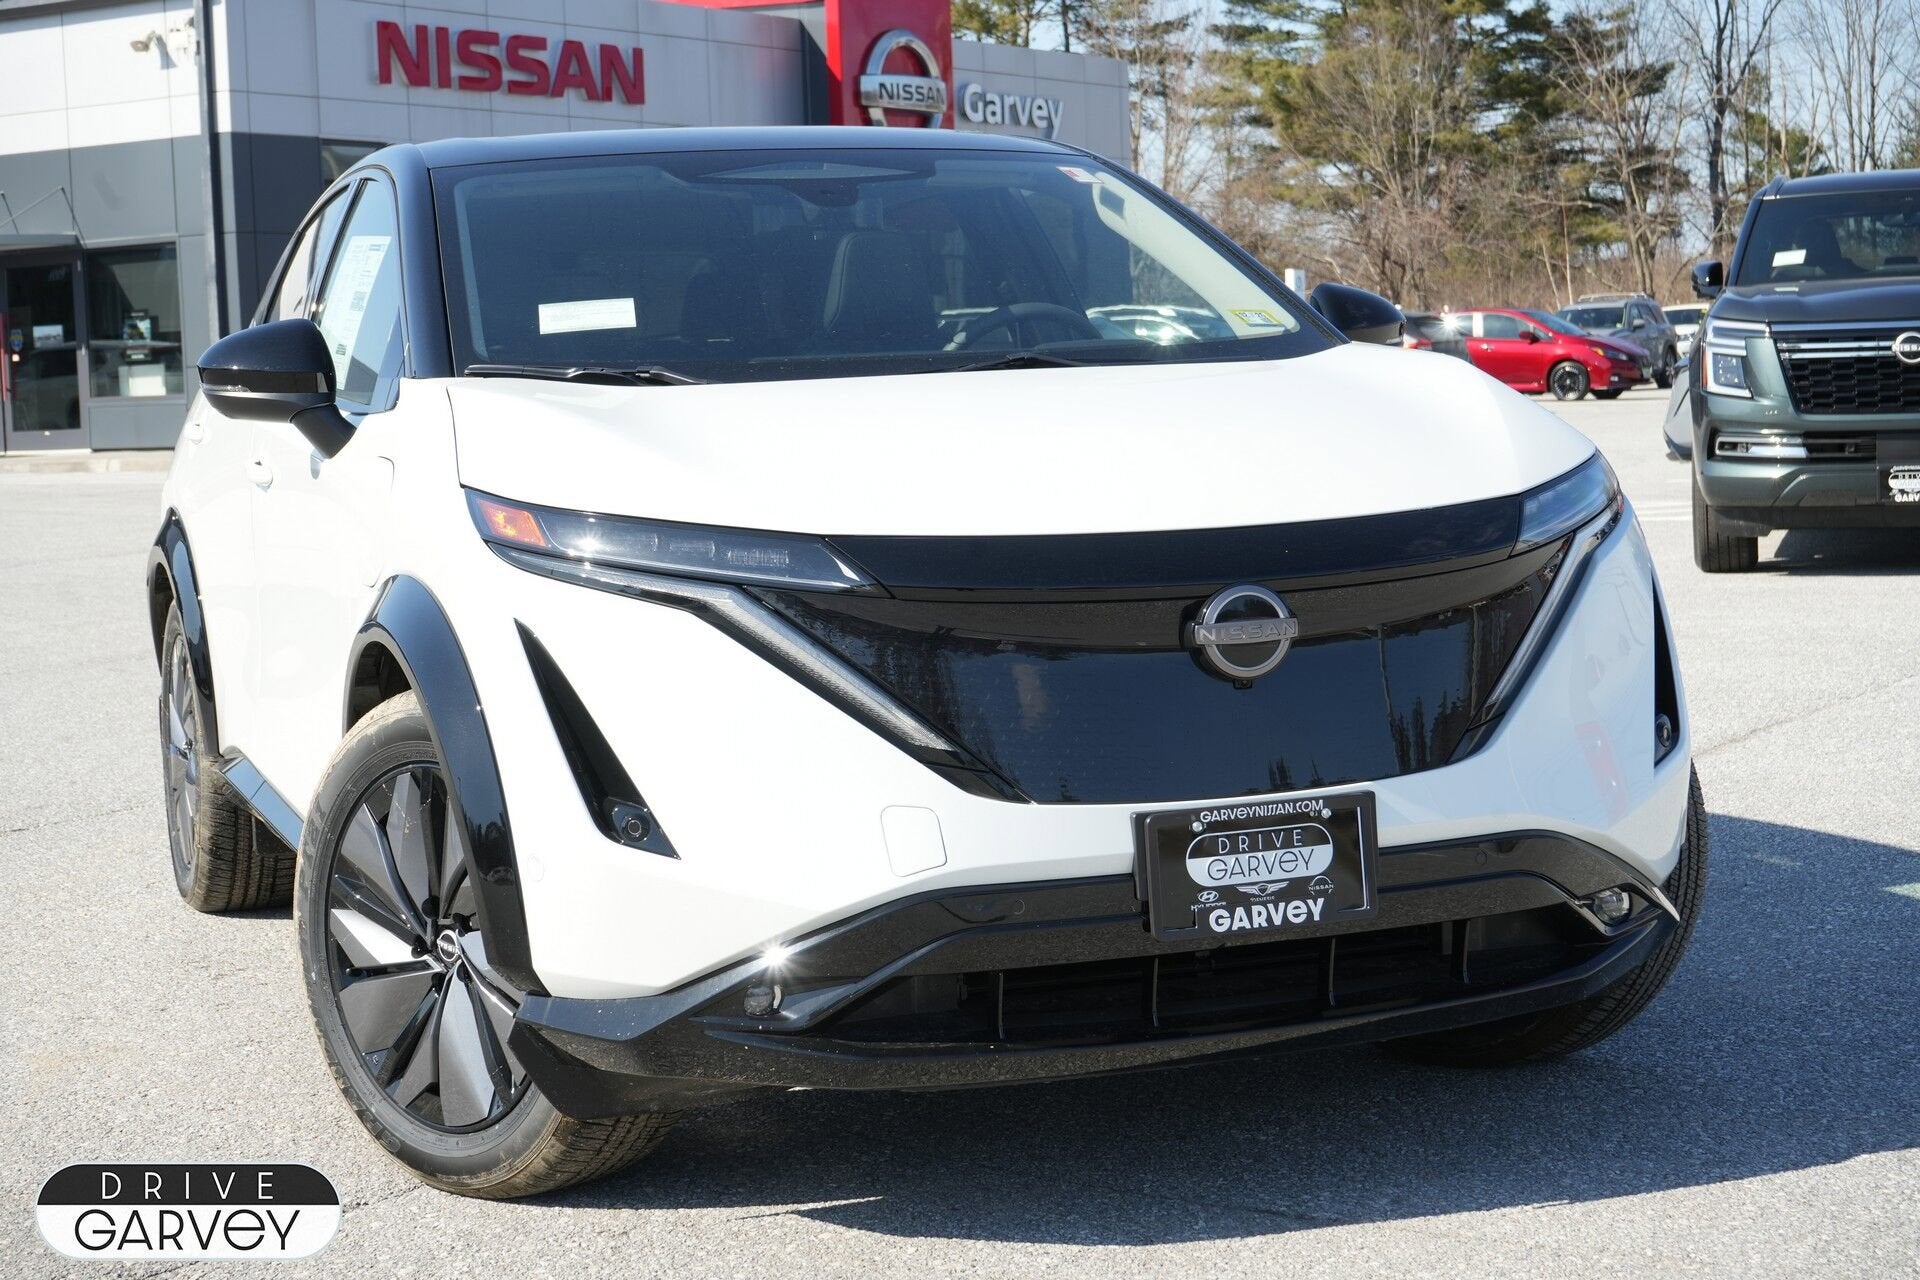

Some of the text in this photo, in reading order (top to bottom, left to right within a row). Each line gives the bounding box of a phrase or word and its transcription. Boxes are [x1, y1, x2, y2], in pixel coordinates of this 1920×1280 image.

[376, 20, 646, 105] NISSAN
[878, 82, 945, 105] NISSAN
[963, 82, 1064, 140] Garvey
[1199, 619, 1298, 642] NISSAN
[1218, 829, 1303, 854] DRIVE
